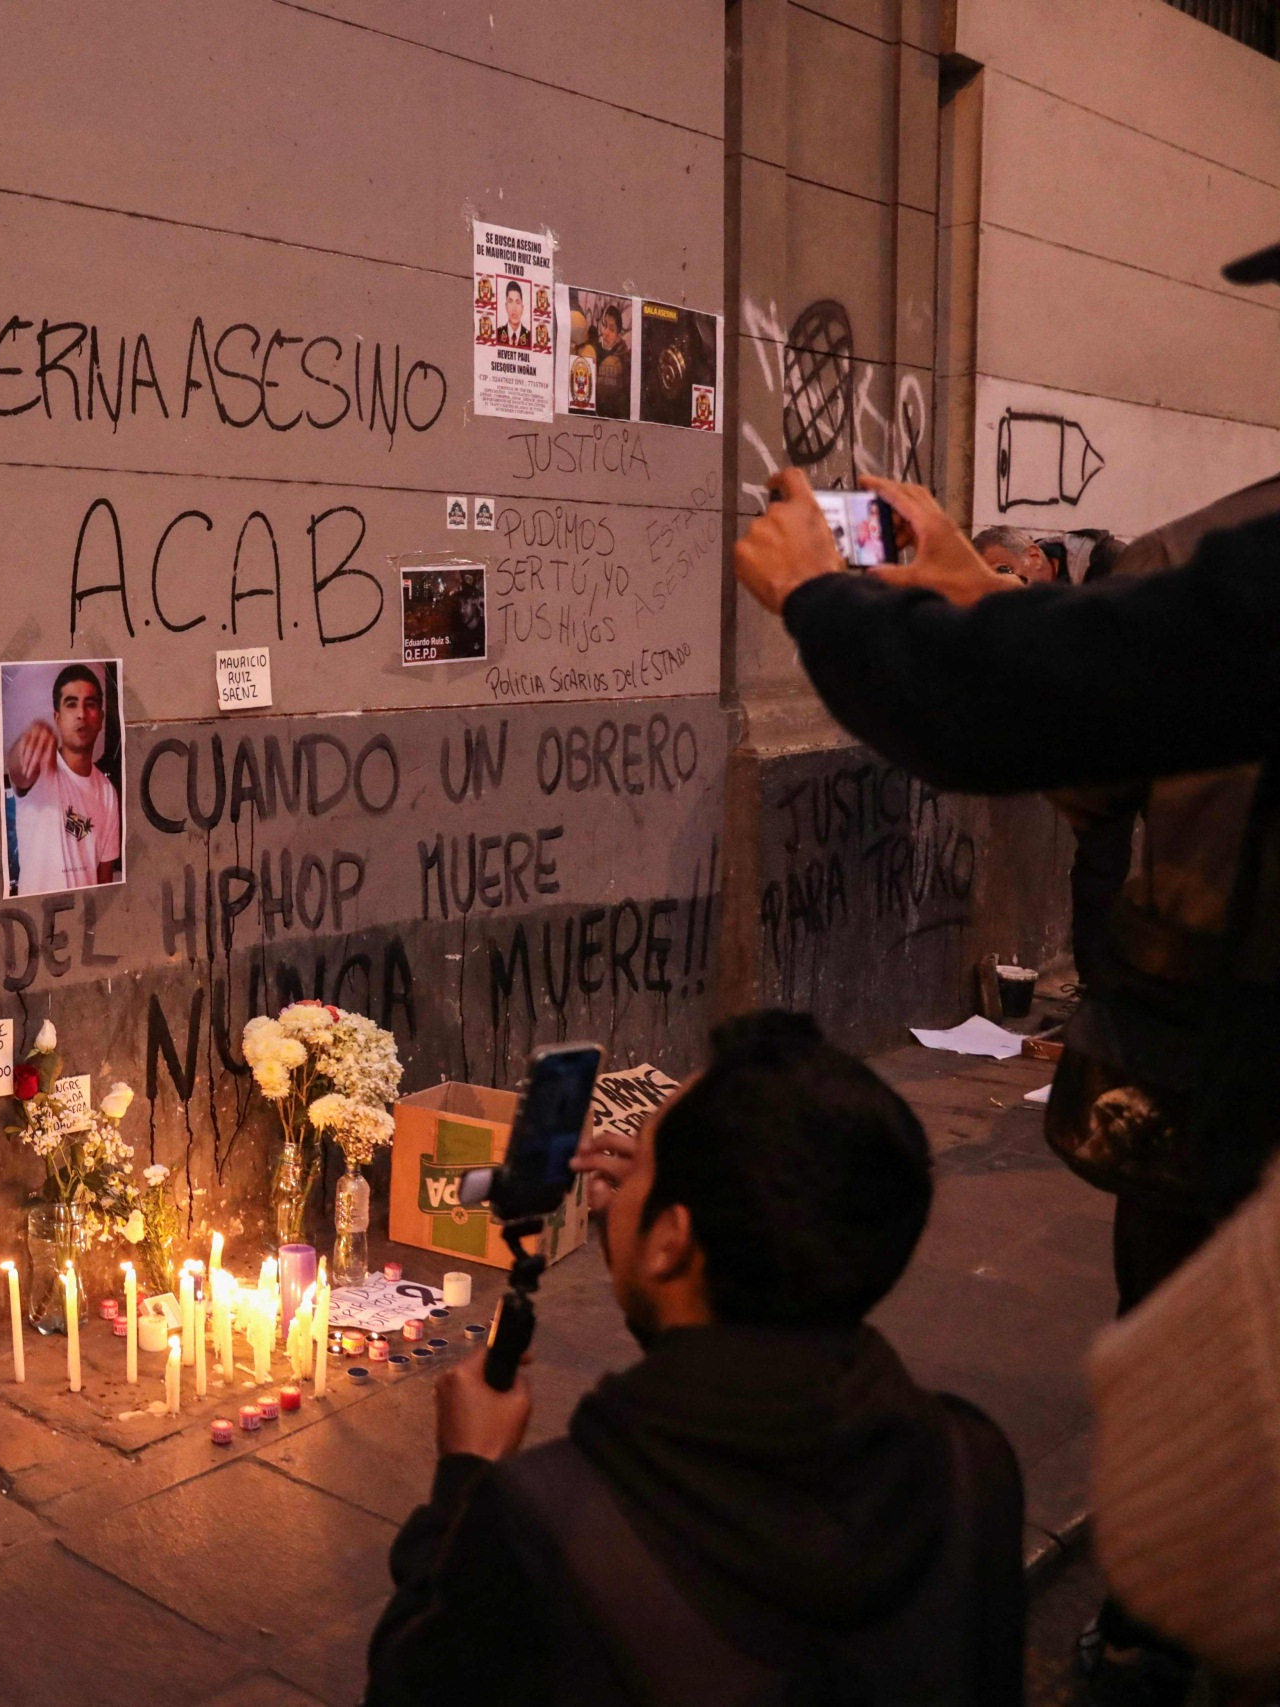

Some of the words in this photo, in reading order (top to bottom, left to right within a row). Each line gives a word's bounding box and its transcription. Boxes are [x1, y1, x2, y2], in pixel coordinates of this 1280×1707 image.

[485, 232, 494, 243] SE
[495, 235, 515, 249] BUSCA
[516, 238, 542, 254] ASESINO
[477, 244, 485, 255] DE
[485, 245, 517, 262] MAURICIO
[517, 253, 532, 265] RUIZ
[532, 255, 550, 269] SAENZ
[504, 262, 525, 277] TRVKO
[491, 361, 517, 374] SIESQUEN
[497, 349, 517, 361] HEVERT
[517, 352, 531, 363] PAUL
[182, 317, 447, 444] ASESINO
[508, 424, 650, 480] JUSTICIA
[496, 506, 615, 556] PUDIMOS
[71, 498, 384, 648] A.C.A.B
[496, 555, 543, 596] SER
[604, 564, 630, 600] YO
[498, 603, 551, 645] TUS
[404, 638, 430, 647] Eduardo
[430, 636, 444, 645] Ruiz
[220, 654, 267, 670] MAURICIO
[228, 671, 252, 685] RUIZ
[223, 684, 258, 701] SAENZ
[139, 732, 400, 834] CUANDO
[440, 719, 508, 801] UN
[536, 713, 698, 796] OBRERO
[417, 825, 564, 921] MUERE
